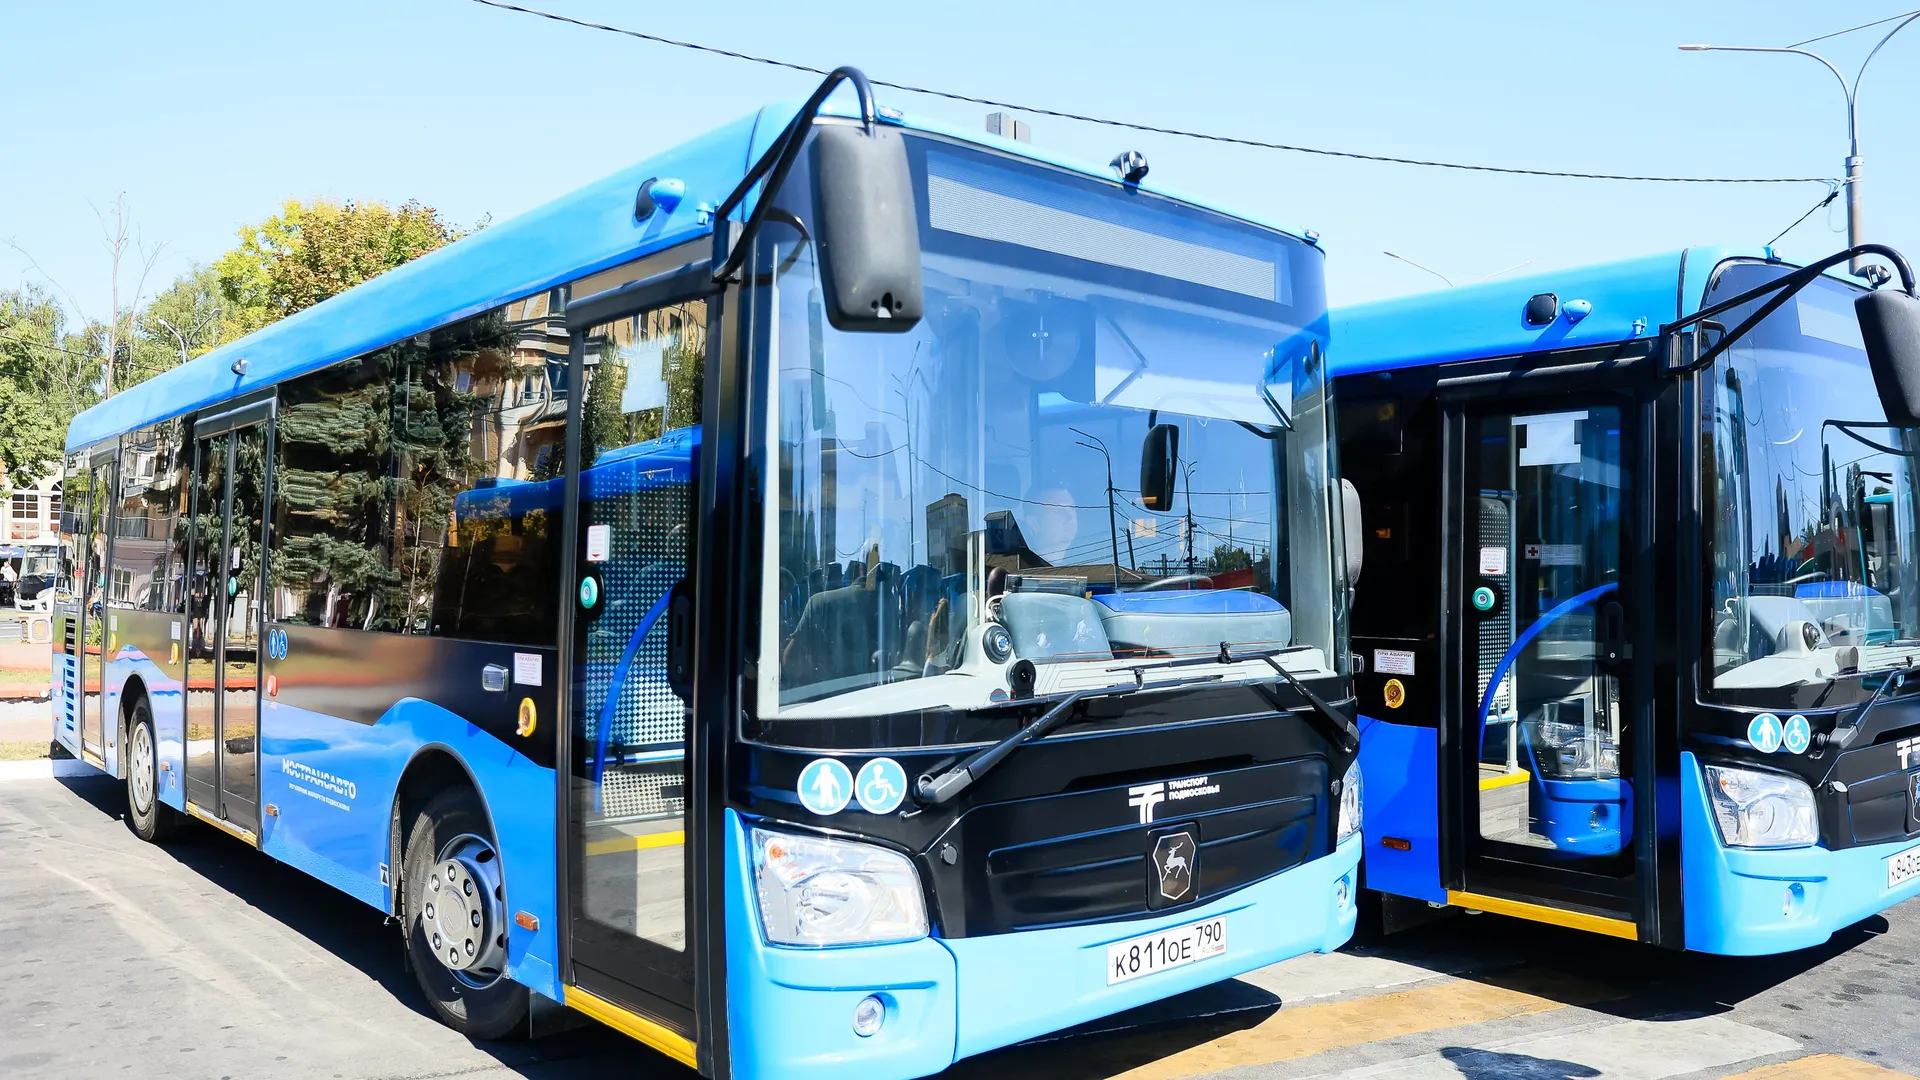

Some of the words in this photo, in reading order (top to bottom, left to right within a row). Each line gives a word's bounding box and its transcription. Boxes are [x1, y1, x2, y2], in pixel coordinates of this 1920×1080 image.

[282, 758, 357, 800] МОСТРАНСАВТО
[1168, 776, 1208, 790] ТРАНСПОРТ
[1168, 784, 1220, 801] ПОДМОСКОВЬЯ
[1116, 937, 1191, 978] К811ОЕ
[1196, 921, 1222, 947] 790
[1202, 945, 1215, 954] RUS
